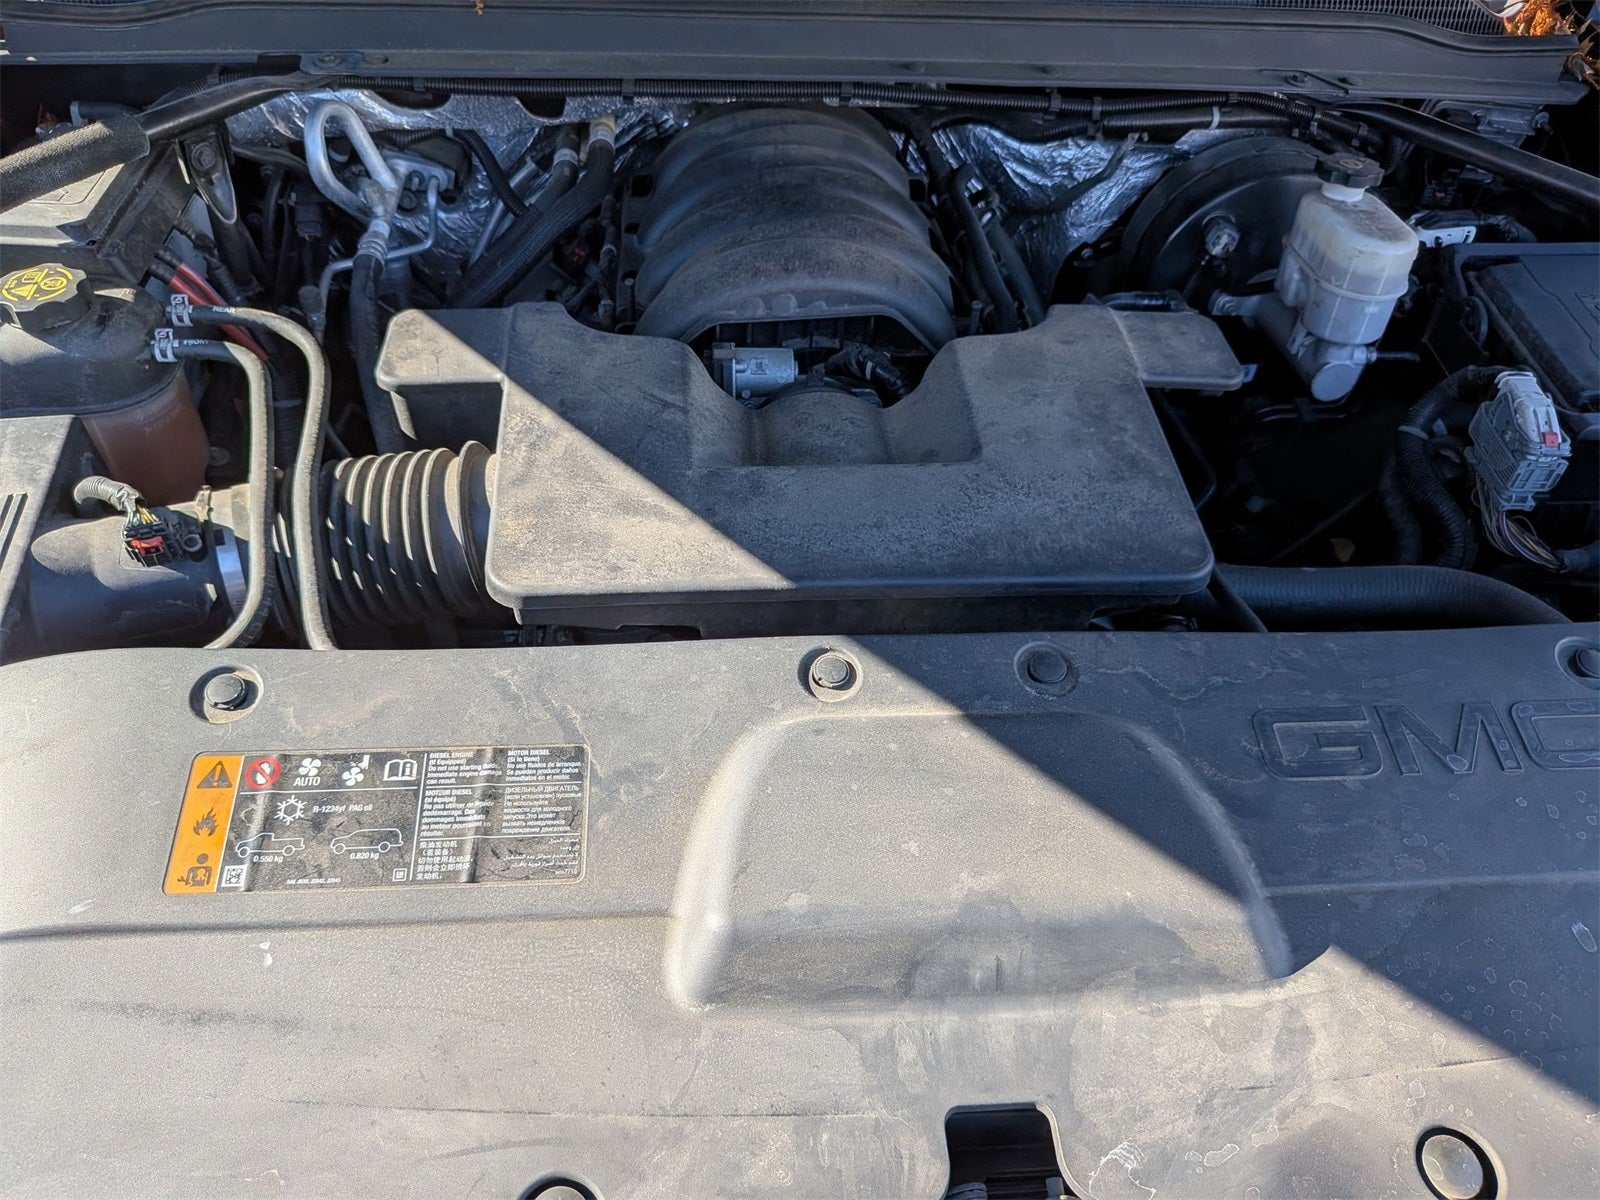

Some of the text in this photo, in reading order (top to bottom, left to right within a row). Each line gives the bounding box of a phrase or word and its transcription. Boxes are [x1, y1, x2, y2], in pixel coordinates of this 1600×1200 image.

[1252, 701, 1600, 781] GMC
[293, 776, 321, 786] AUTO
[312, 804, 346, 813] R-1234yf
[274, 854, 284, 864] kg
[370, 852, 380, 861] kg
